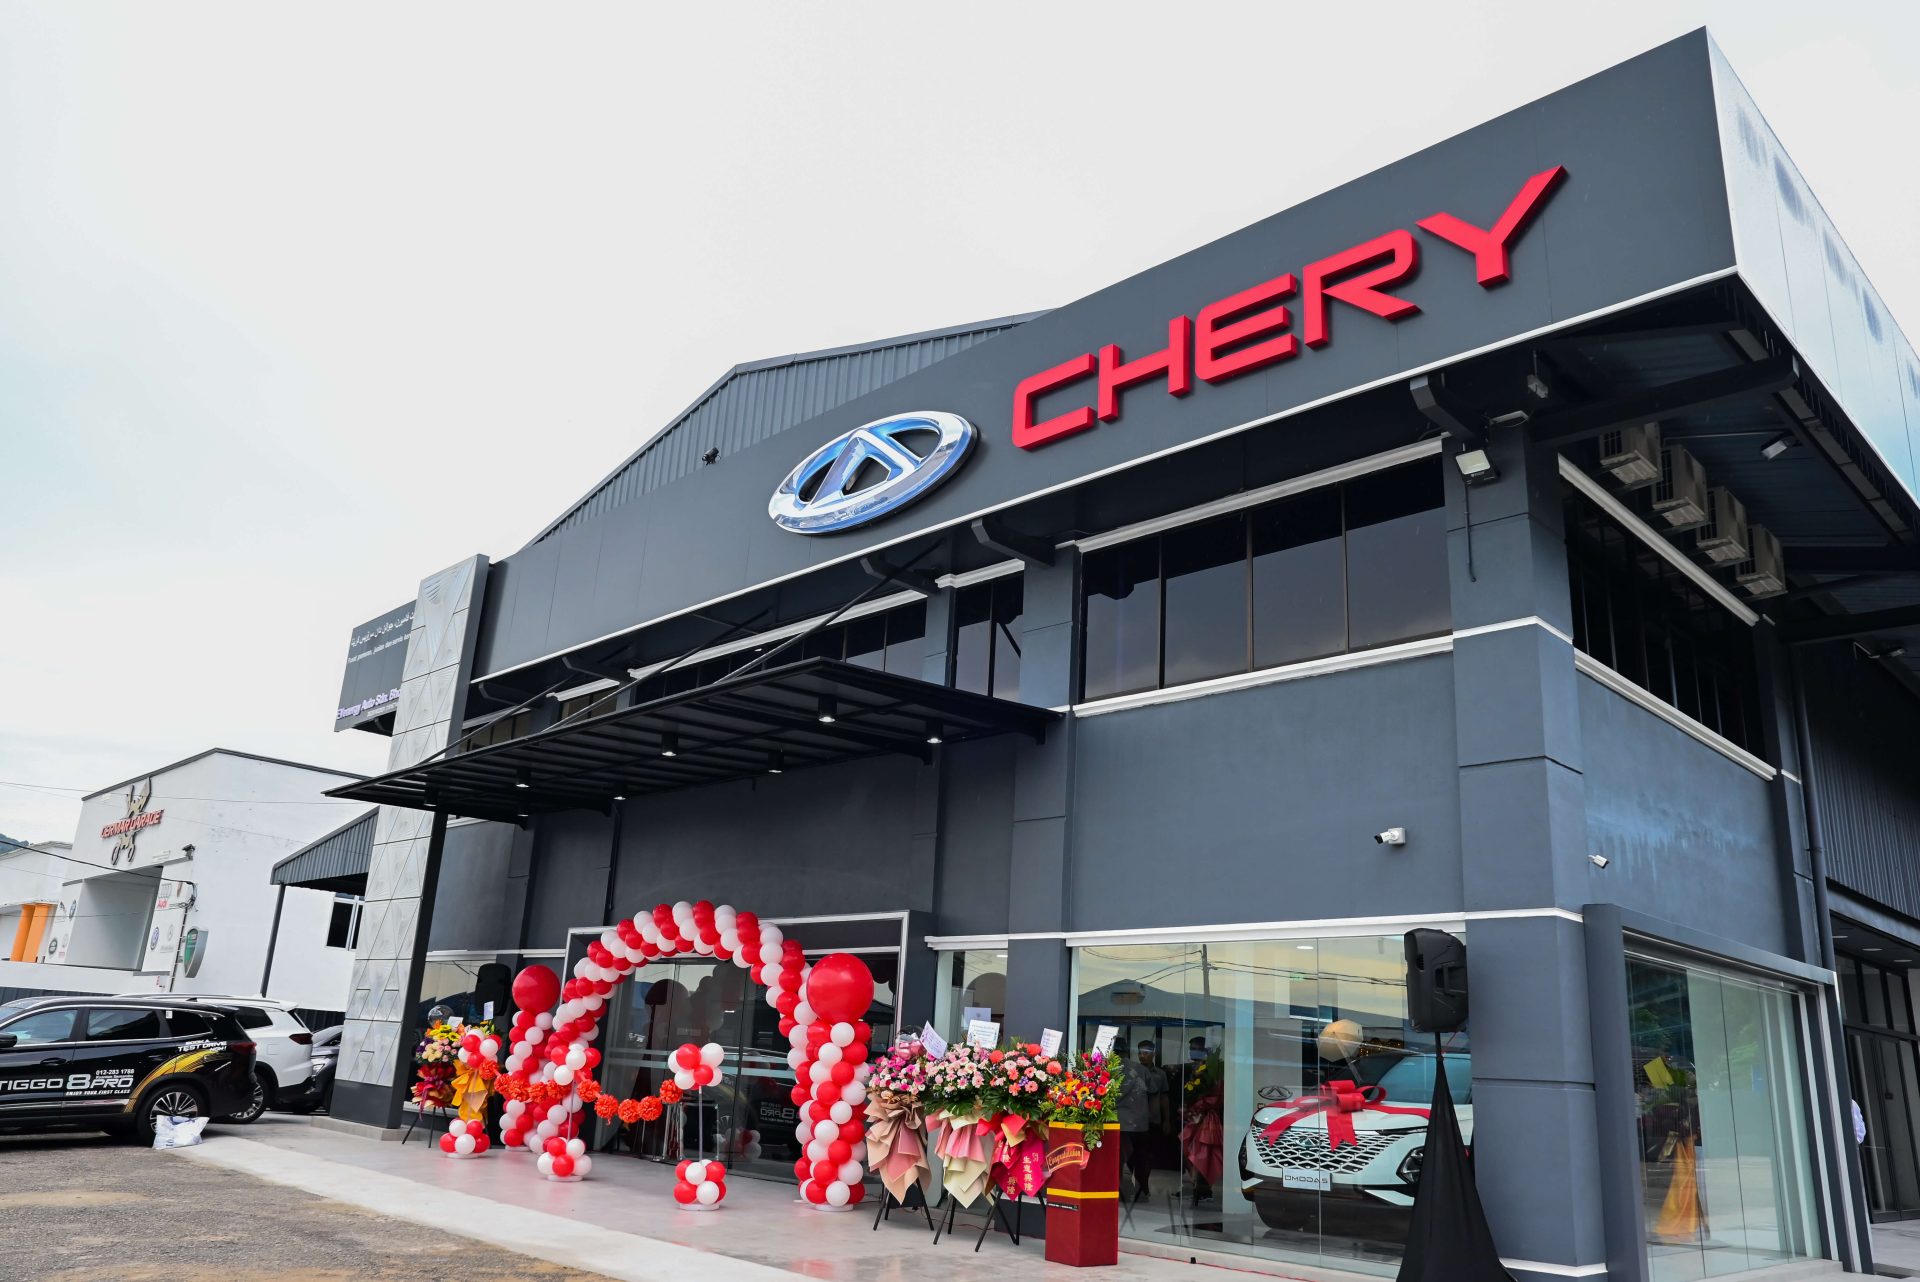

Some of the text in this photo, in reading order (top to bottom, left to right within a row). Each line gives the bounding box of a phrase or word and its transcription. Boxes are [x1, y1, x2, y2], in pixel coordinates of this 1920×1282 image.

[1012, 165, 1570, 450] CHERY
[178, 1041, 227, 1052] TEST DRIVE
[0, 1073, 134, 1090] TIGGO 8 PRO
[1284, 1175, 1320, 1183] OMODA
